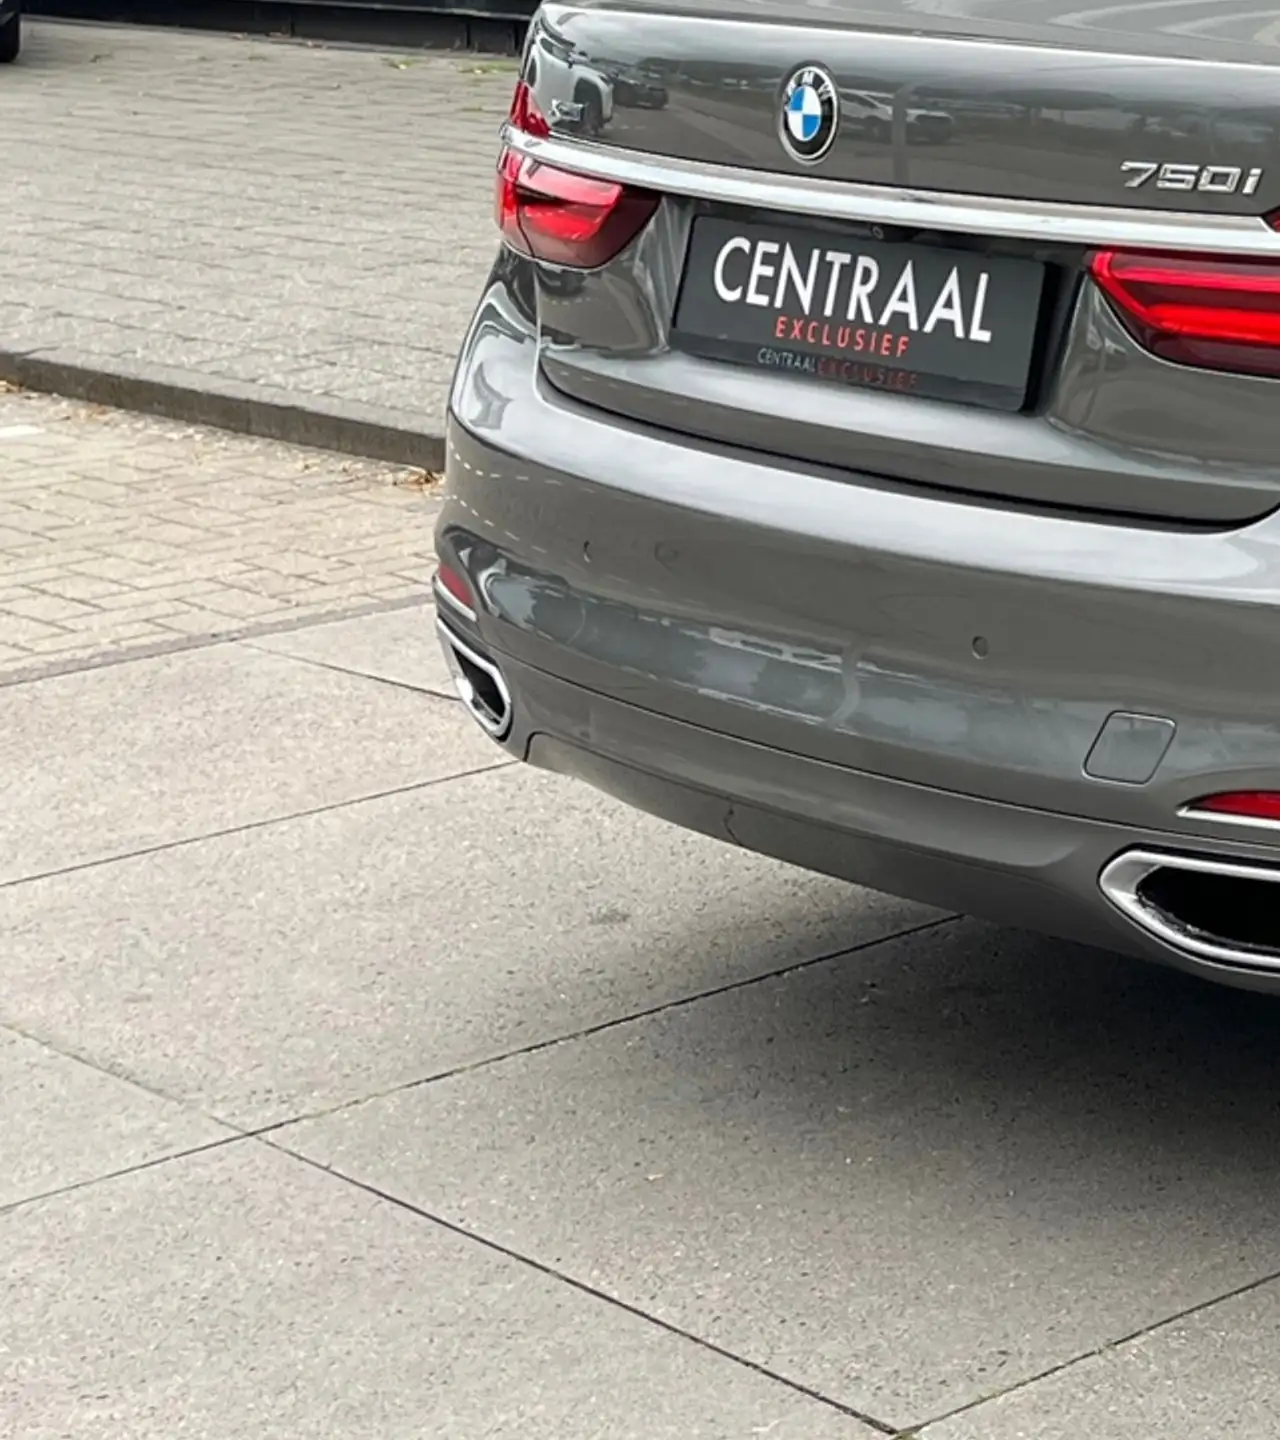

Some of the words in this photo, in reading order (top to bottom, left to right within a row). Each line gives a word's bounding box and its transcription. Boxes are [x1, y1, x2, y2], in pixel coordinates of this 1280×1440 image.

[1120, 161, 1262, 196] 750i
[714, 236, 992, 342] CENTRAAL
[775, 316, 909, 357] EXCLUSIEF
[757, 347, 815, 373] CENTRAAL
